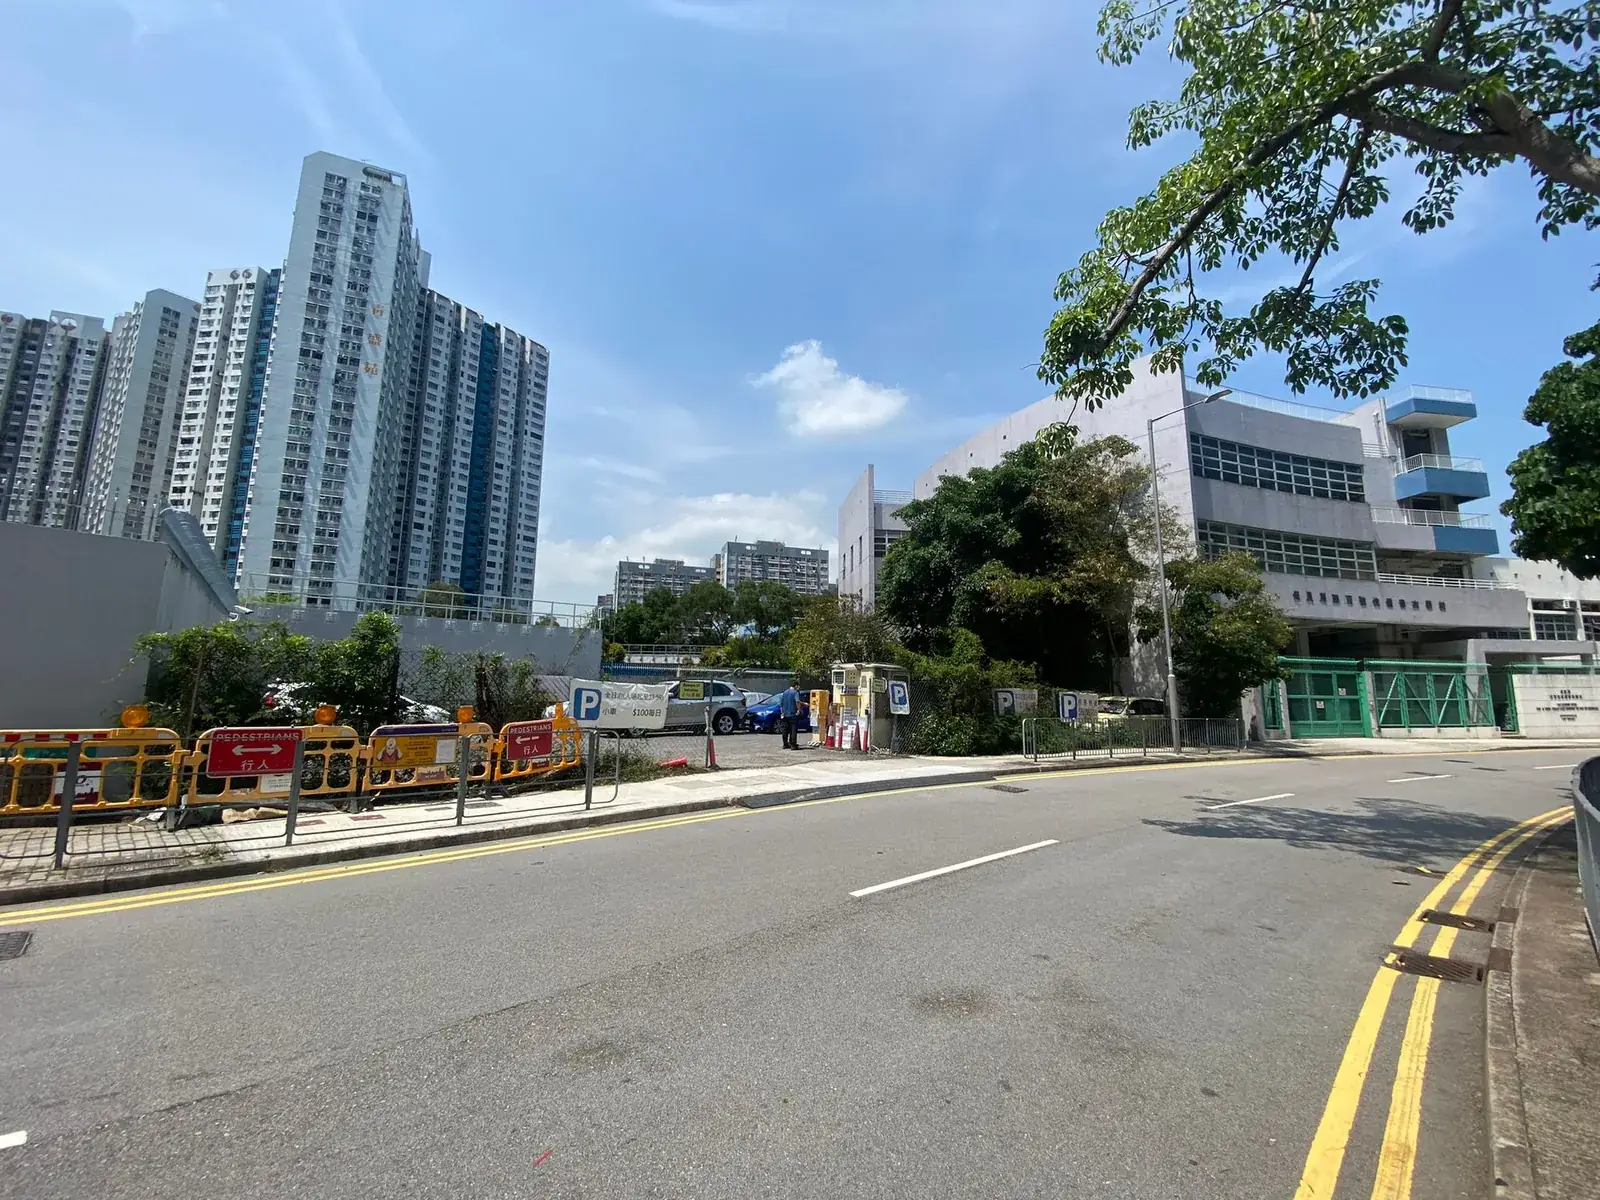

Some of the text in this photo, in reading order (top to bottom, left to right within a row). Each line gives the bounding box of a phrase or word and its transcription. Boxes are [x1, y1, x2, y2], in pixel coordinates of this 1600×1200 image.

[893, 686, 905, 703] P
[581, 690, 599, 718] P
[997, 692, 1013, 716] P
[1063, 695, 1076, 717] P
[509, 723, 552, 734] PEDESTRIANS
[216, 732, 300, 742] PEDESTRIANS
[523, 744, 539, 755] 行人
[241, 759, 271, 771] 行人
